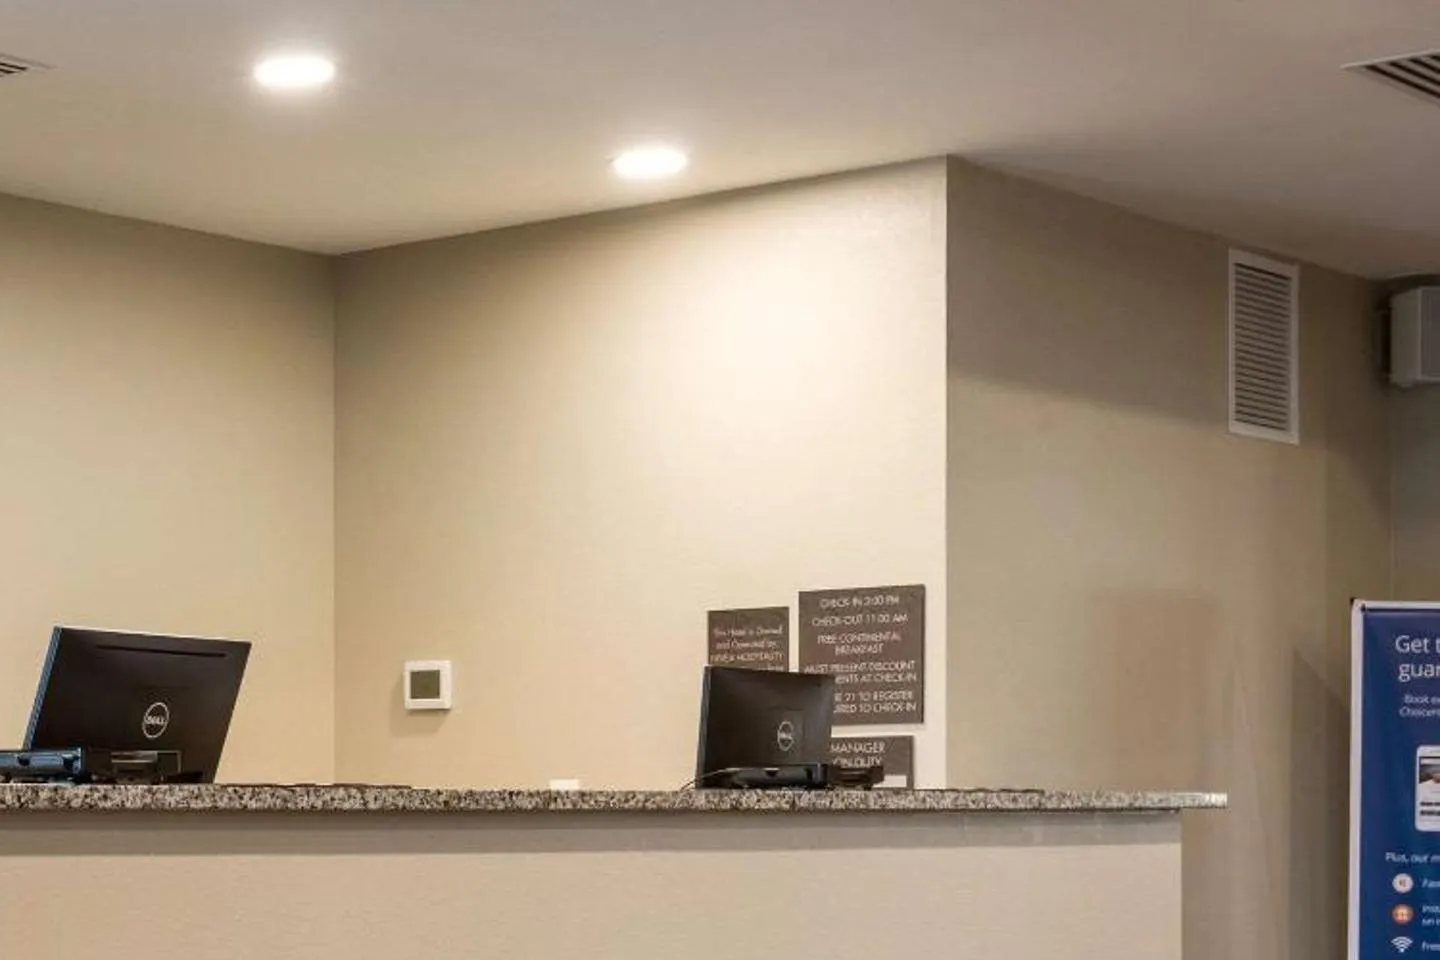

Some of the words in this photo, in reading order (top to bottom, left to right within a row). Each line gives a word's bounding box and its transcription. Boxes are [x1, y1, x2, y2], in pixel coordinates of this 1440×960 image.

[885, 595, 899, 605] PM
[893, 613, 909, 623] AM
[839, 631, 901, 644] CONTINENTAL
[835, 643, 885, 656] BREAKFAST
[1395, 635, 1429, 654] Get
[868, 660, 916, 671] DISCOUNT
[873, 702, 917, 713] CHECK-IN
[830, 741, 886, 753] MANAGER
